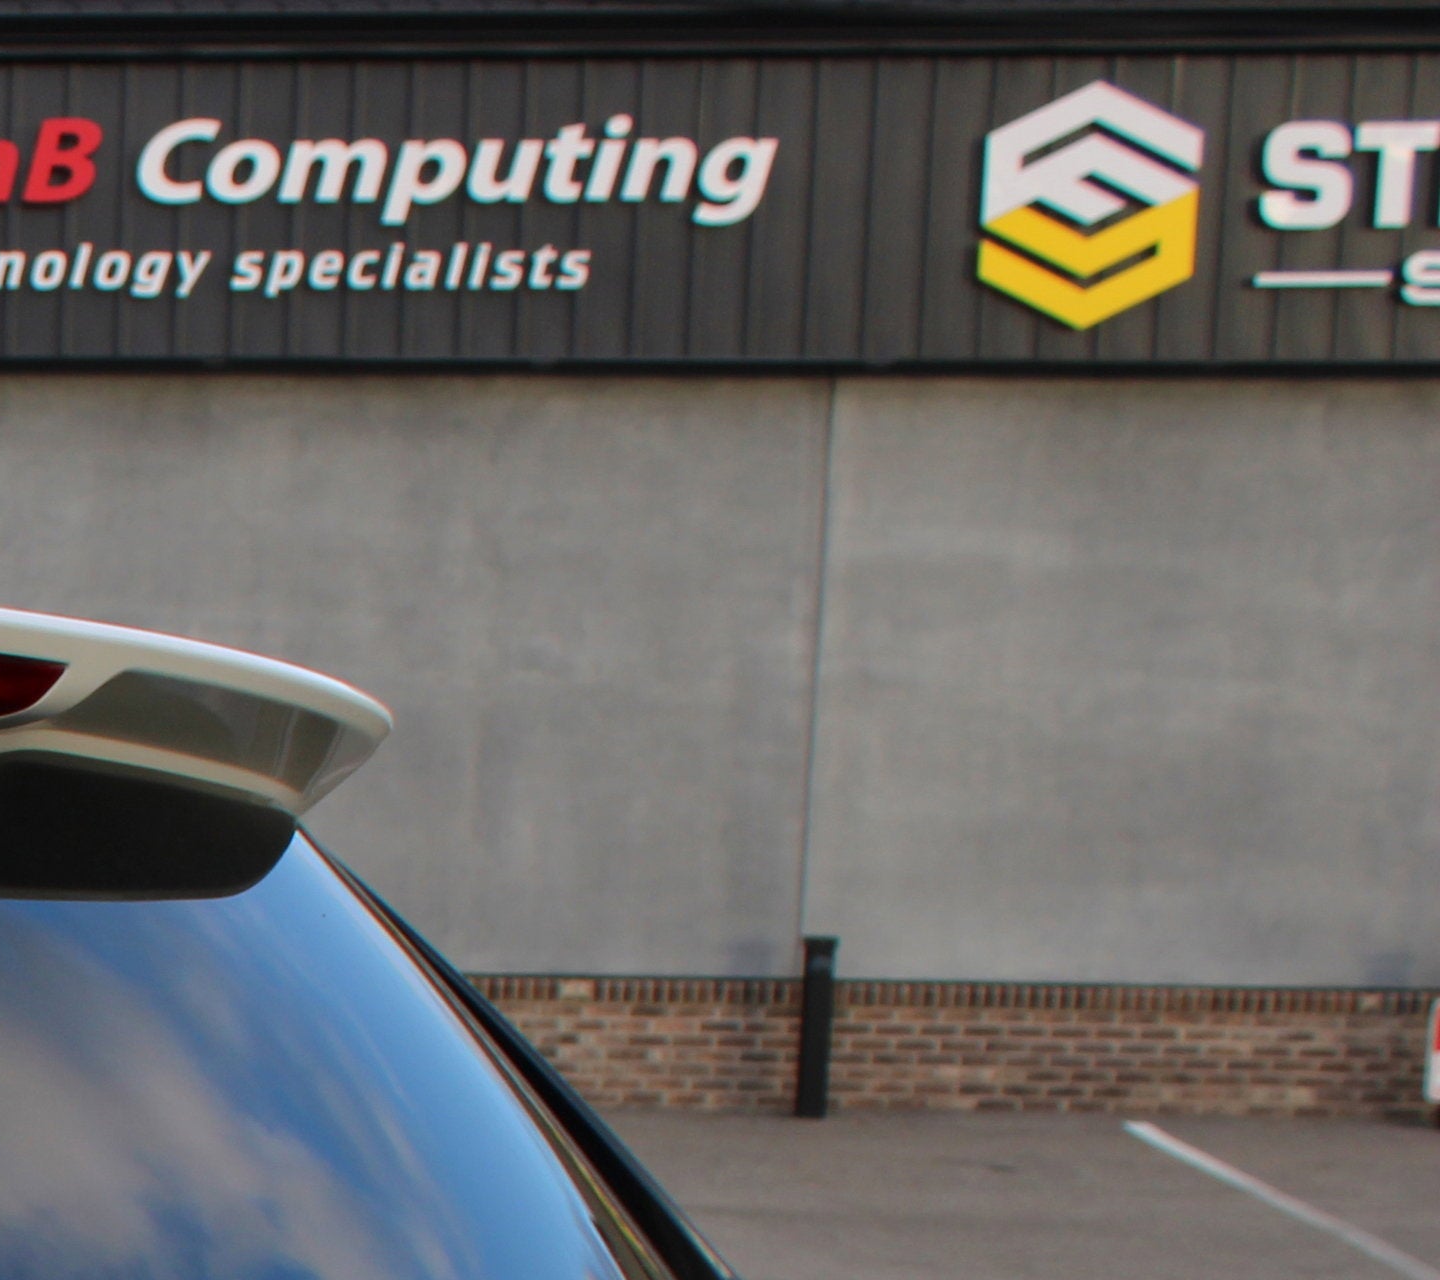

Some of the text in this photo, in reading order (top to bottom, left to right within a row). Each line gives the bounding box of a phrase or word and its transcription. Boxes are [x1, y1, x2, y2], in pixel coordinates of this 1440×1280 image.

[135, 113, 779, 227] Computing
[1258, 120, 1440, 231] ST
[229, 241, 593, 299] specialists
